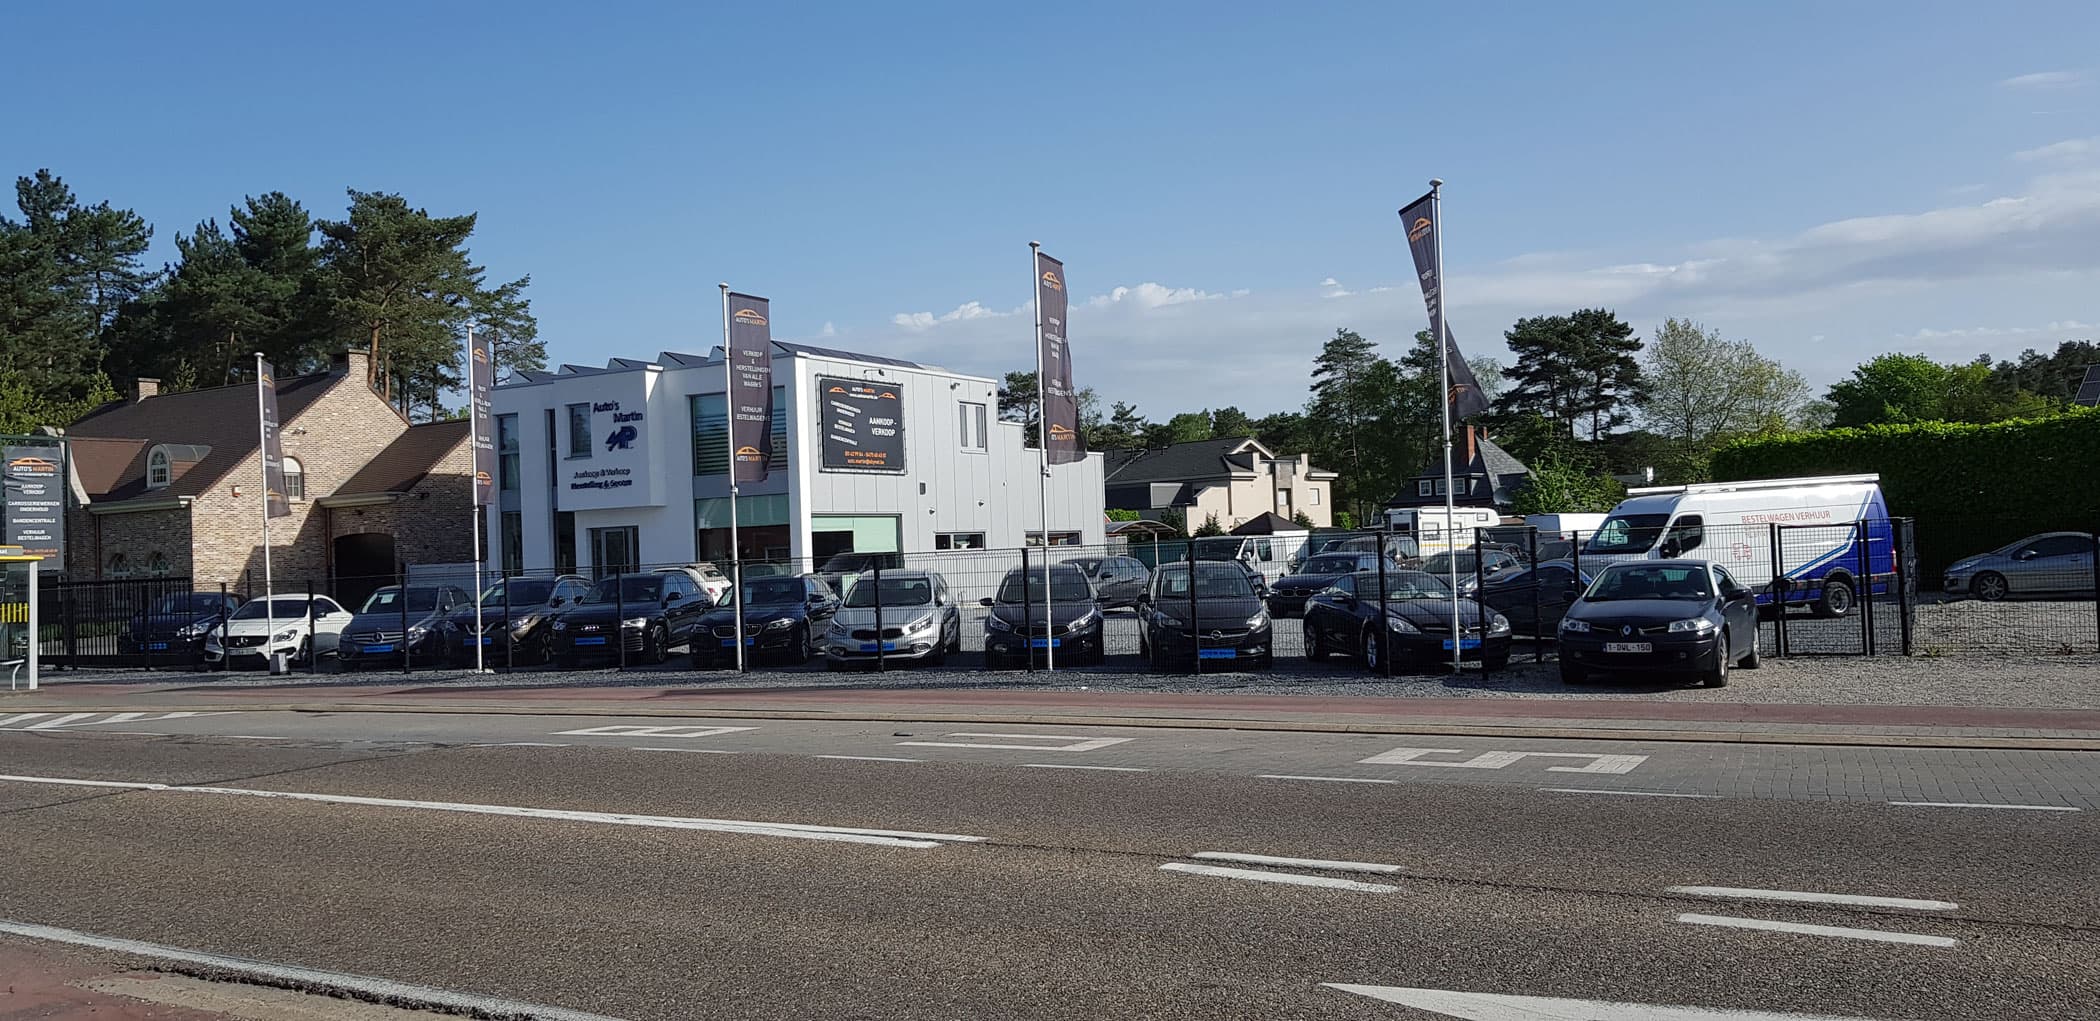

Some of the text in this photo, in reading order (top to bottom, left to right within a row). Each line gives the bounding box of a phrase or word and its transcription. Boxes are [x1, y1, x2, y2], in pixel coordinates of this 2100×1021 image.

[593, 400, 619, 413] Auto's
[613, 411, 643, 423] Martin
[869, 417, 894, 426] AANKOOP
[872, 428, 895, 436] VERKOOP
[1741, 510, 1831, 524] BESTELWAGEN VERHUUR
